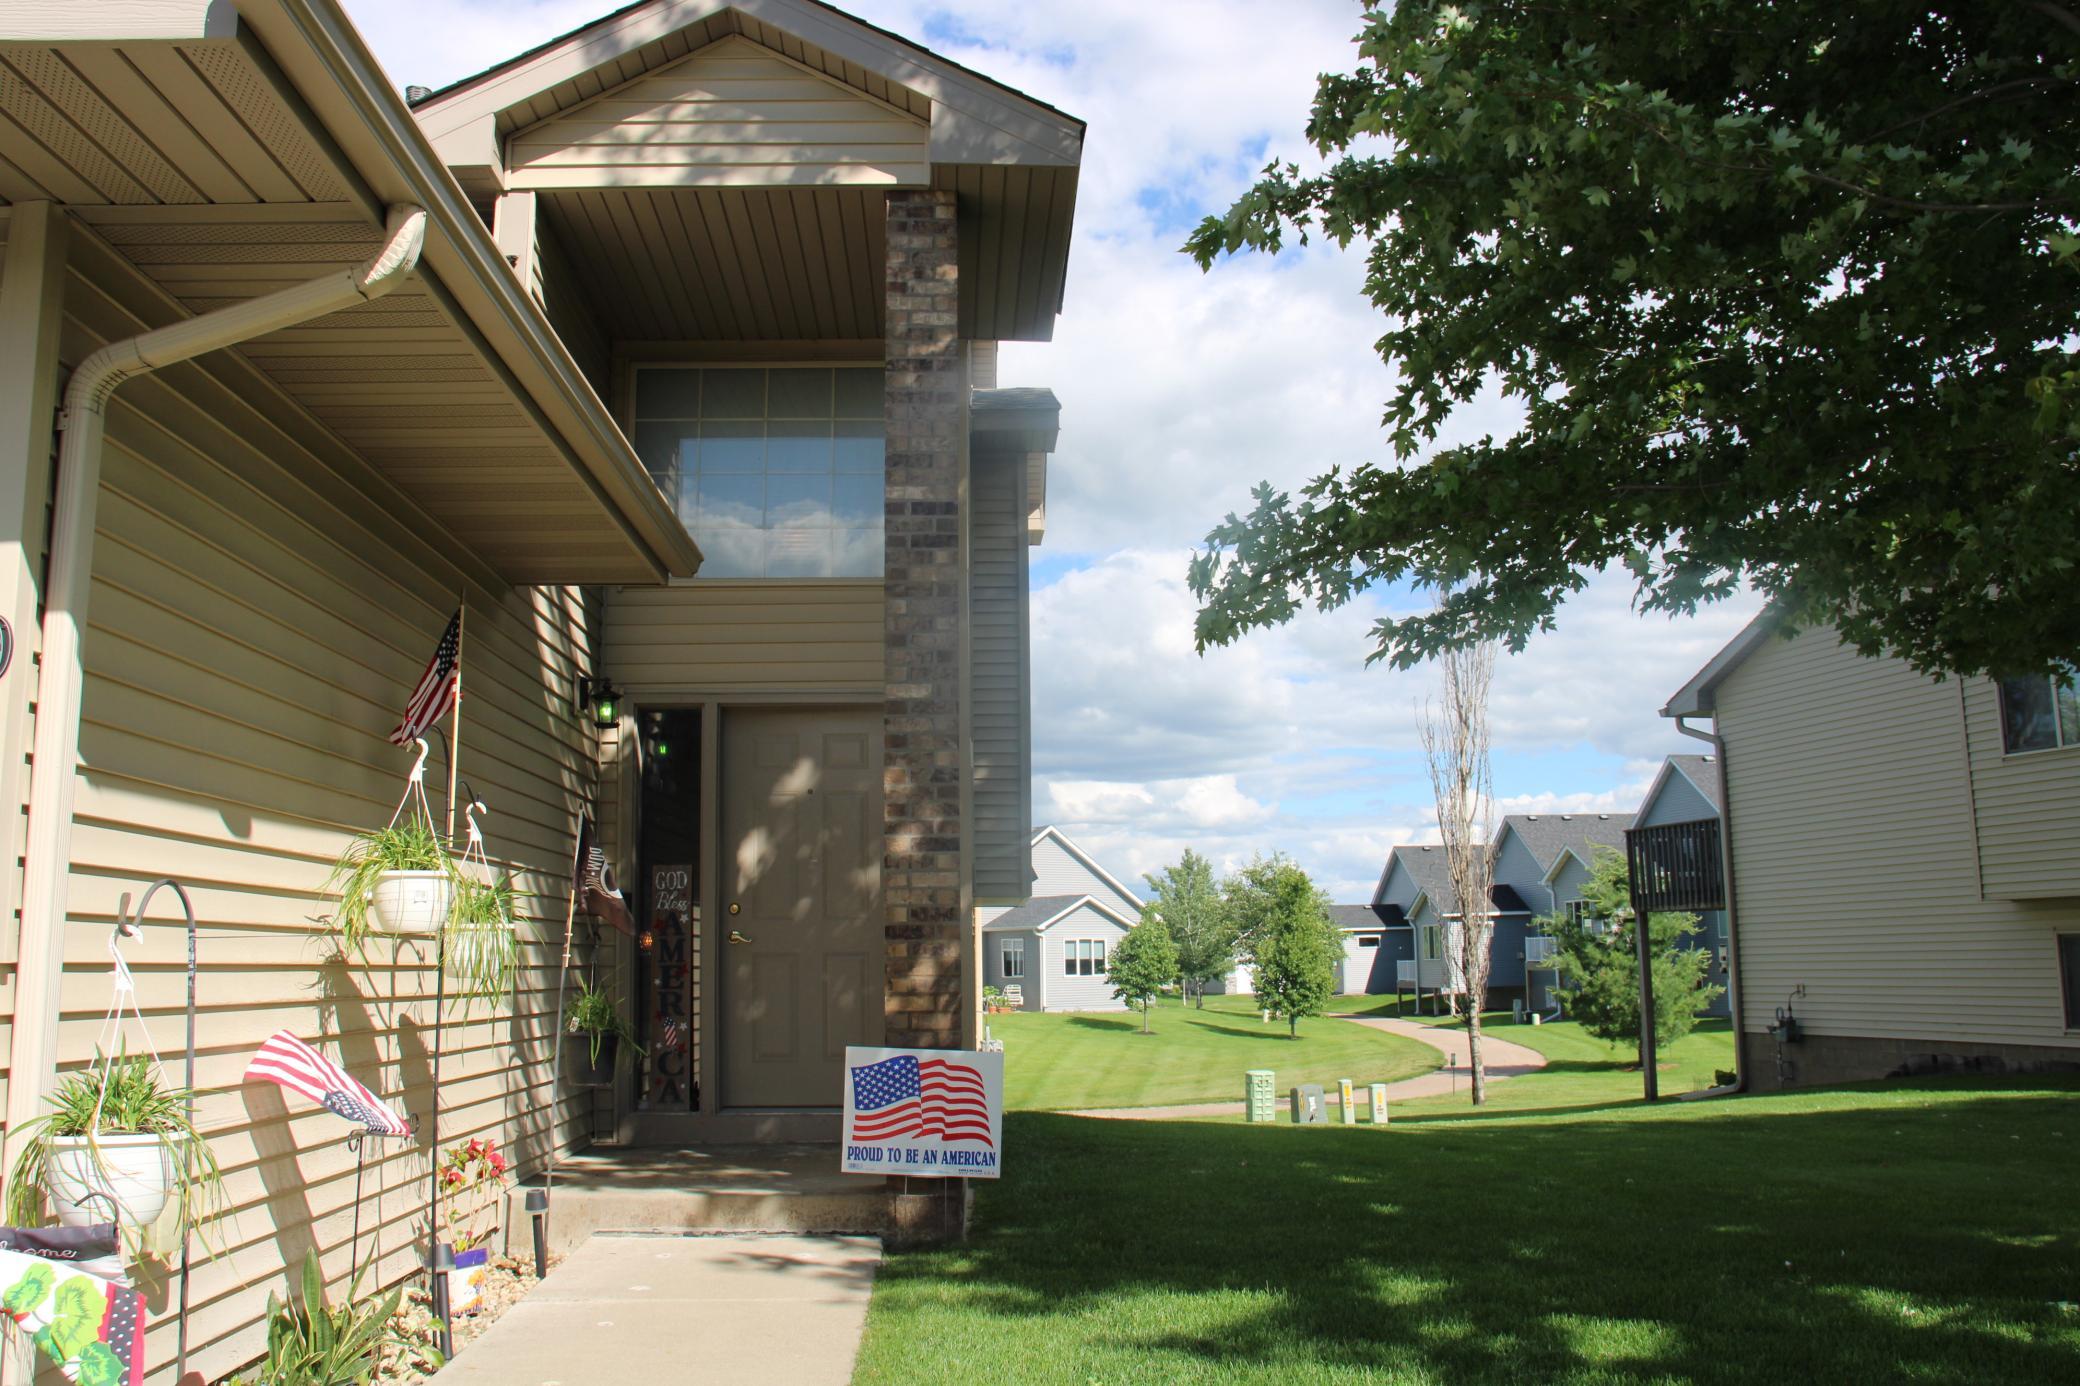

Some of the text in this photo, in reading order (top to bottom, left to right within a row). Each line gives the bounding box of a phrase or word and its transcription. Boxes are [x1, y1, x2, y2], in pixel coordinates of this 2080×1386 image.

[656, 871, 687, 889] GOD
[656, 890, 689, 911] Bless
[847, 1145, 996, 1167] PROUD TO BE AN AMERICAN
